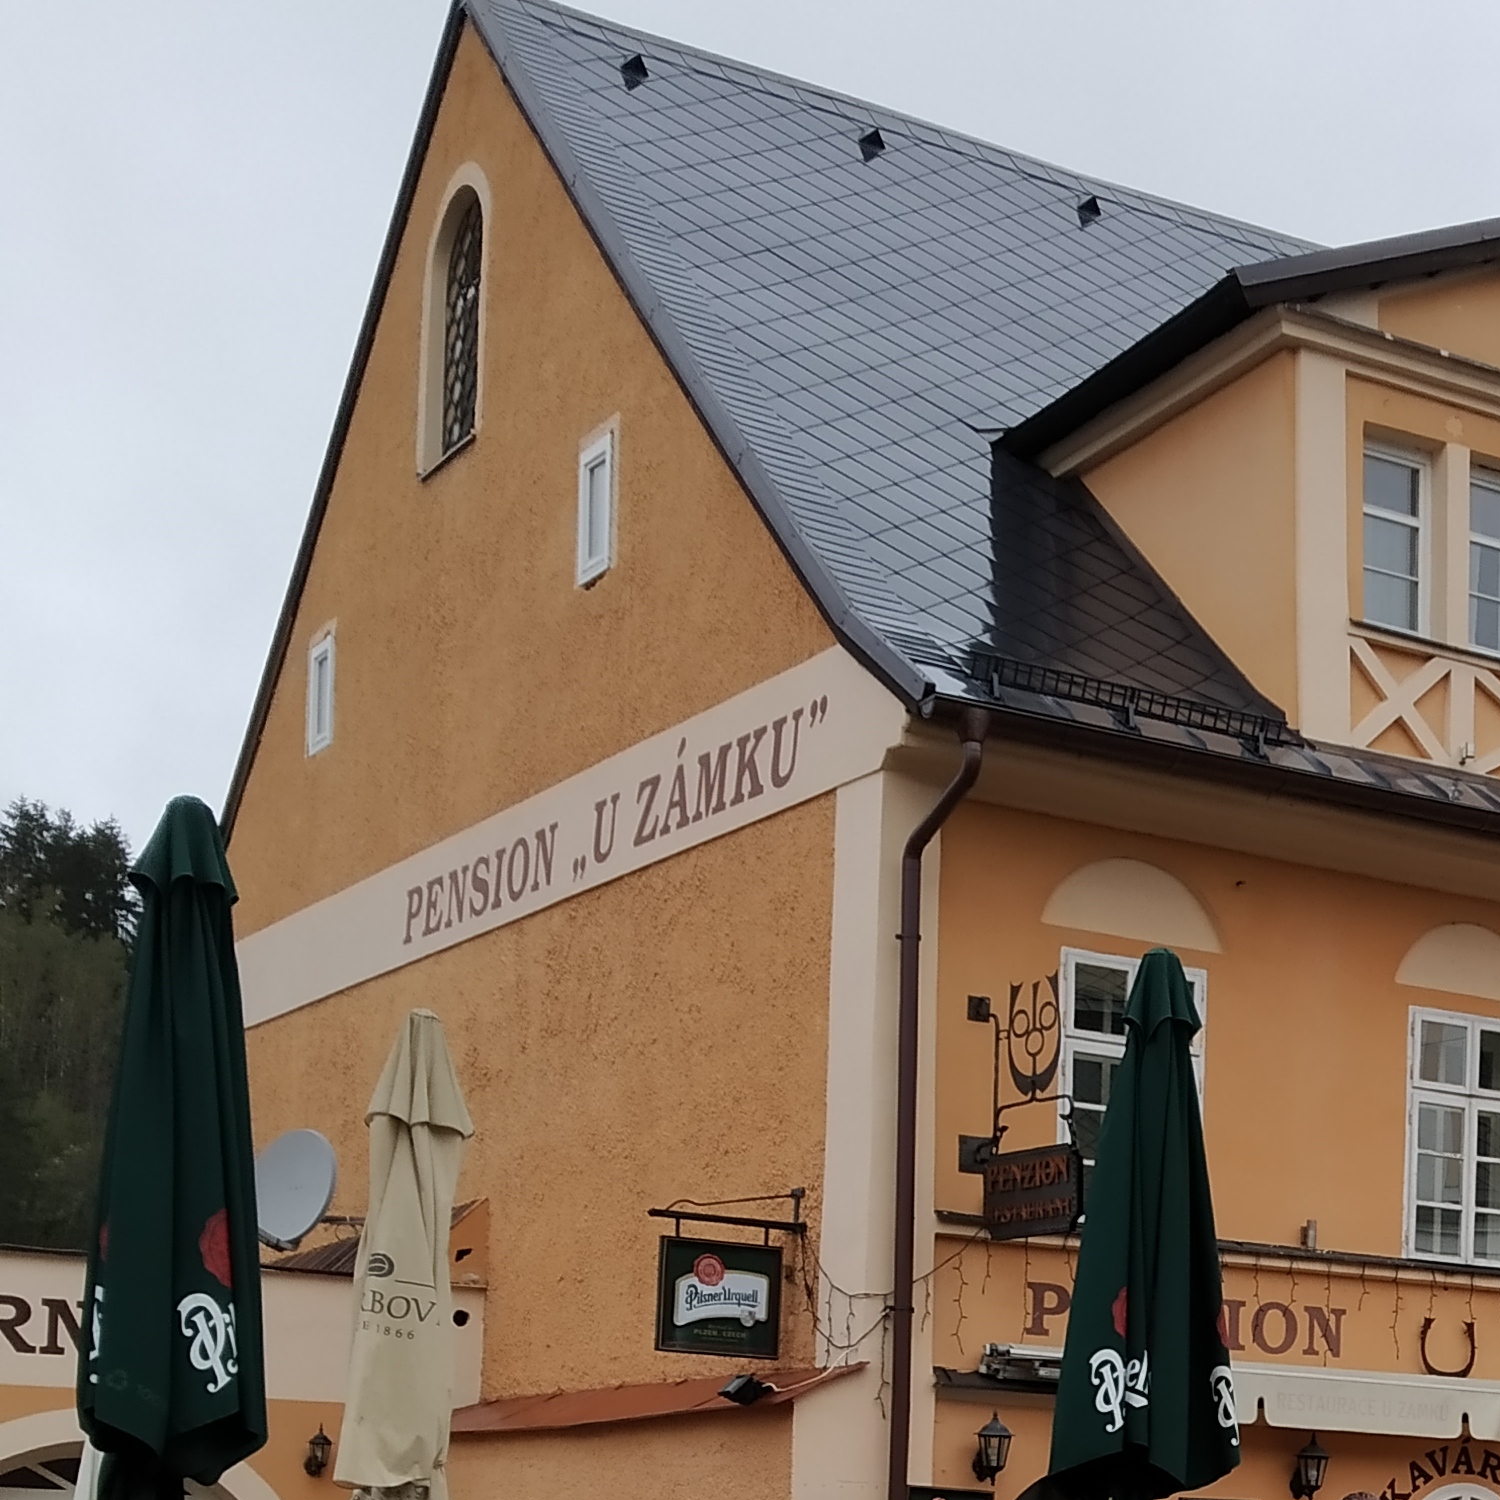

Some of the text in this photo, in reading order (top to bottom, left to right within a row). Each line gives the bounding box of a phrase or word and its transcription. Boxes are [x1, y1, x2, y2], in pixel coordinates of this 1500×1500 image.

[403, 821, 558, 945] PENSION
[987, 1155, 1068, 1193] PENZION
[685, 1284, 759, 1311] Pilsner Urquell
[375, 1320, 415, 1340] 1866
[1420, 1316, 1477, 1378] U
